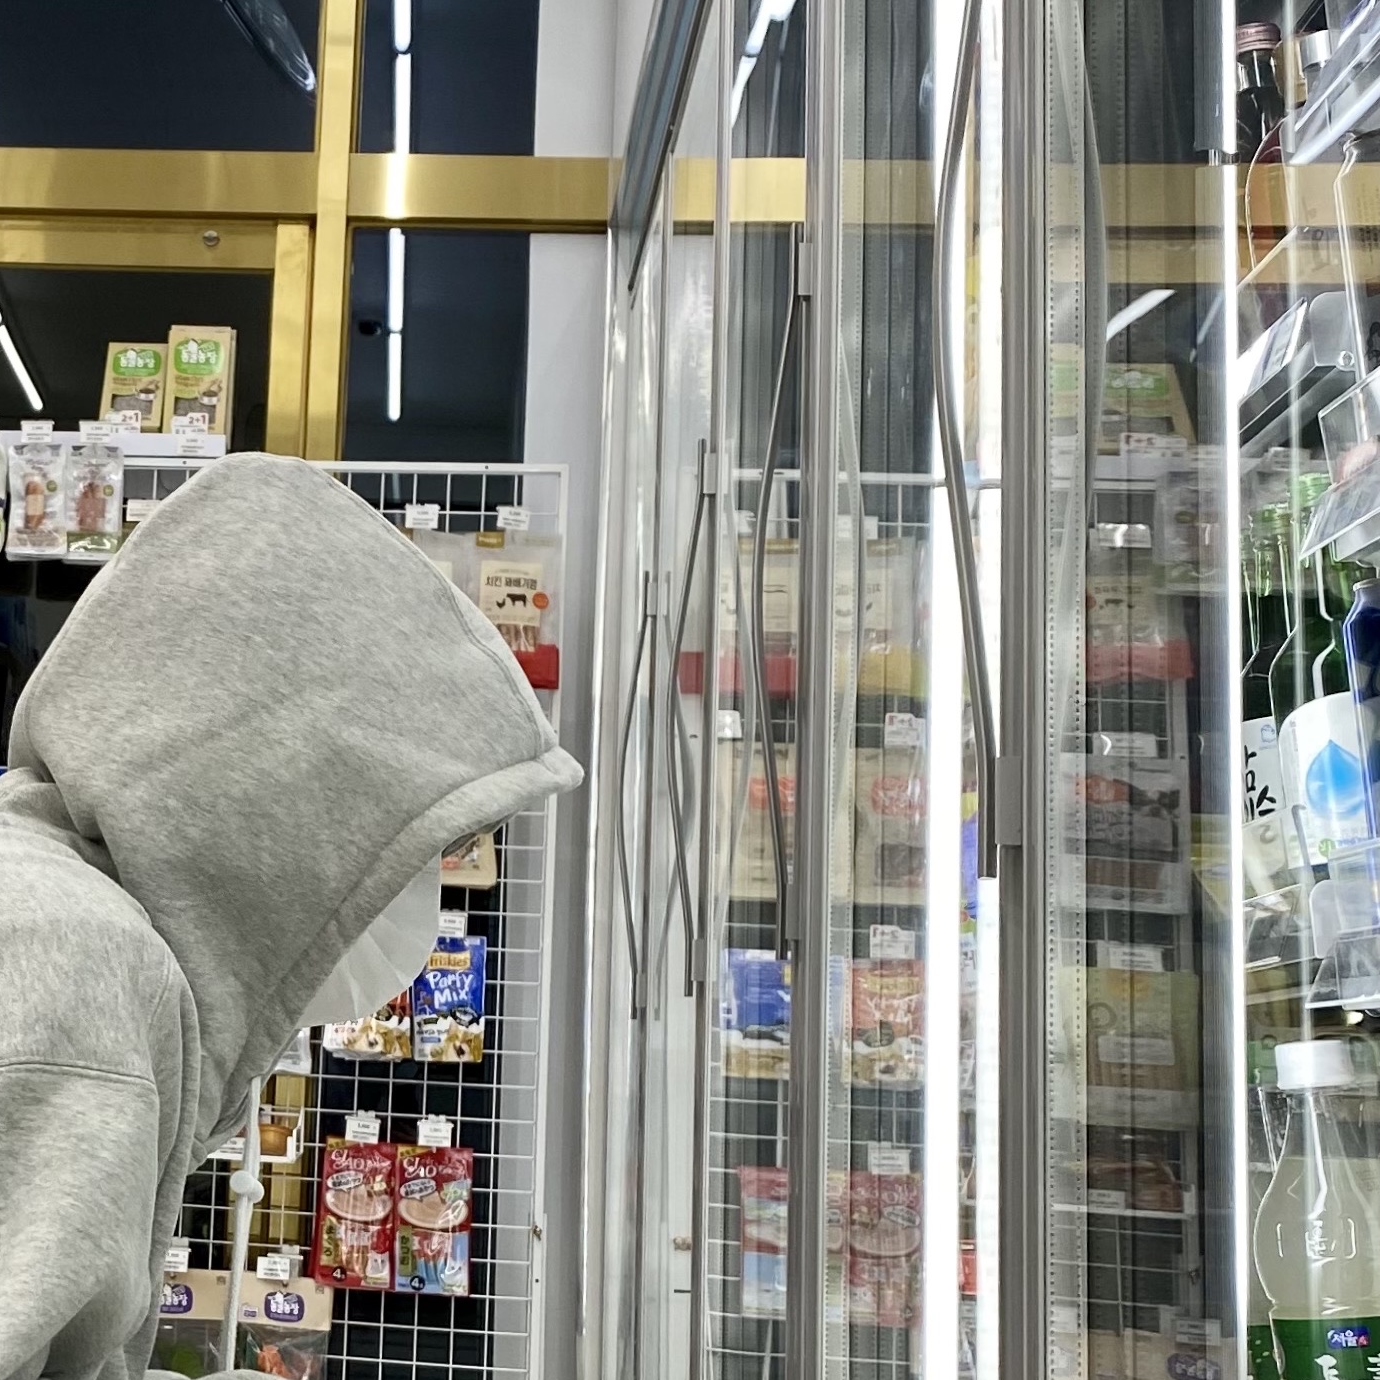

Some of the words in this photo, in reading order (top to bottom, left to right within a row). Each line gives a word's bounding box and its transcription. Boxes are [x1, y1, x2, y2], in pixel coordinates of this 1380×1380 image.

[121, 411, 140, 424] 2+1
[188, 414, 206, 426] 2+1
[425, 971, 474, 990] Party
[433, 989, 468, 1009] Mix
